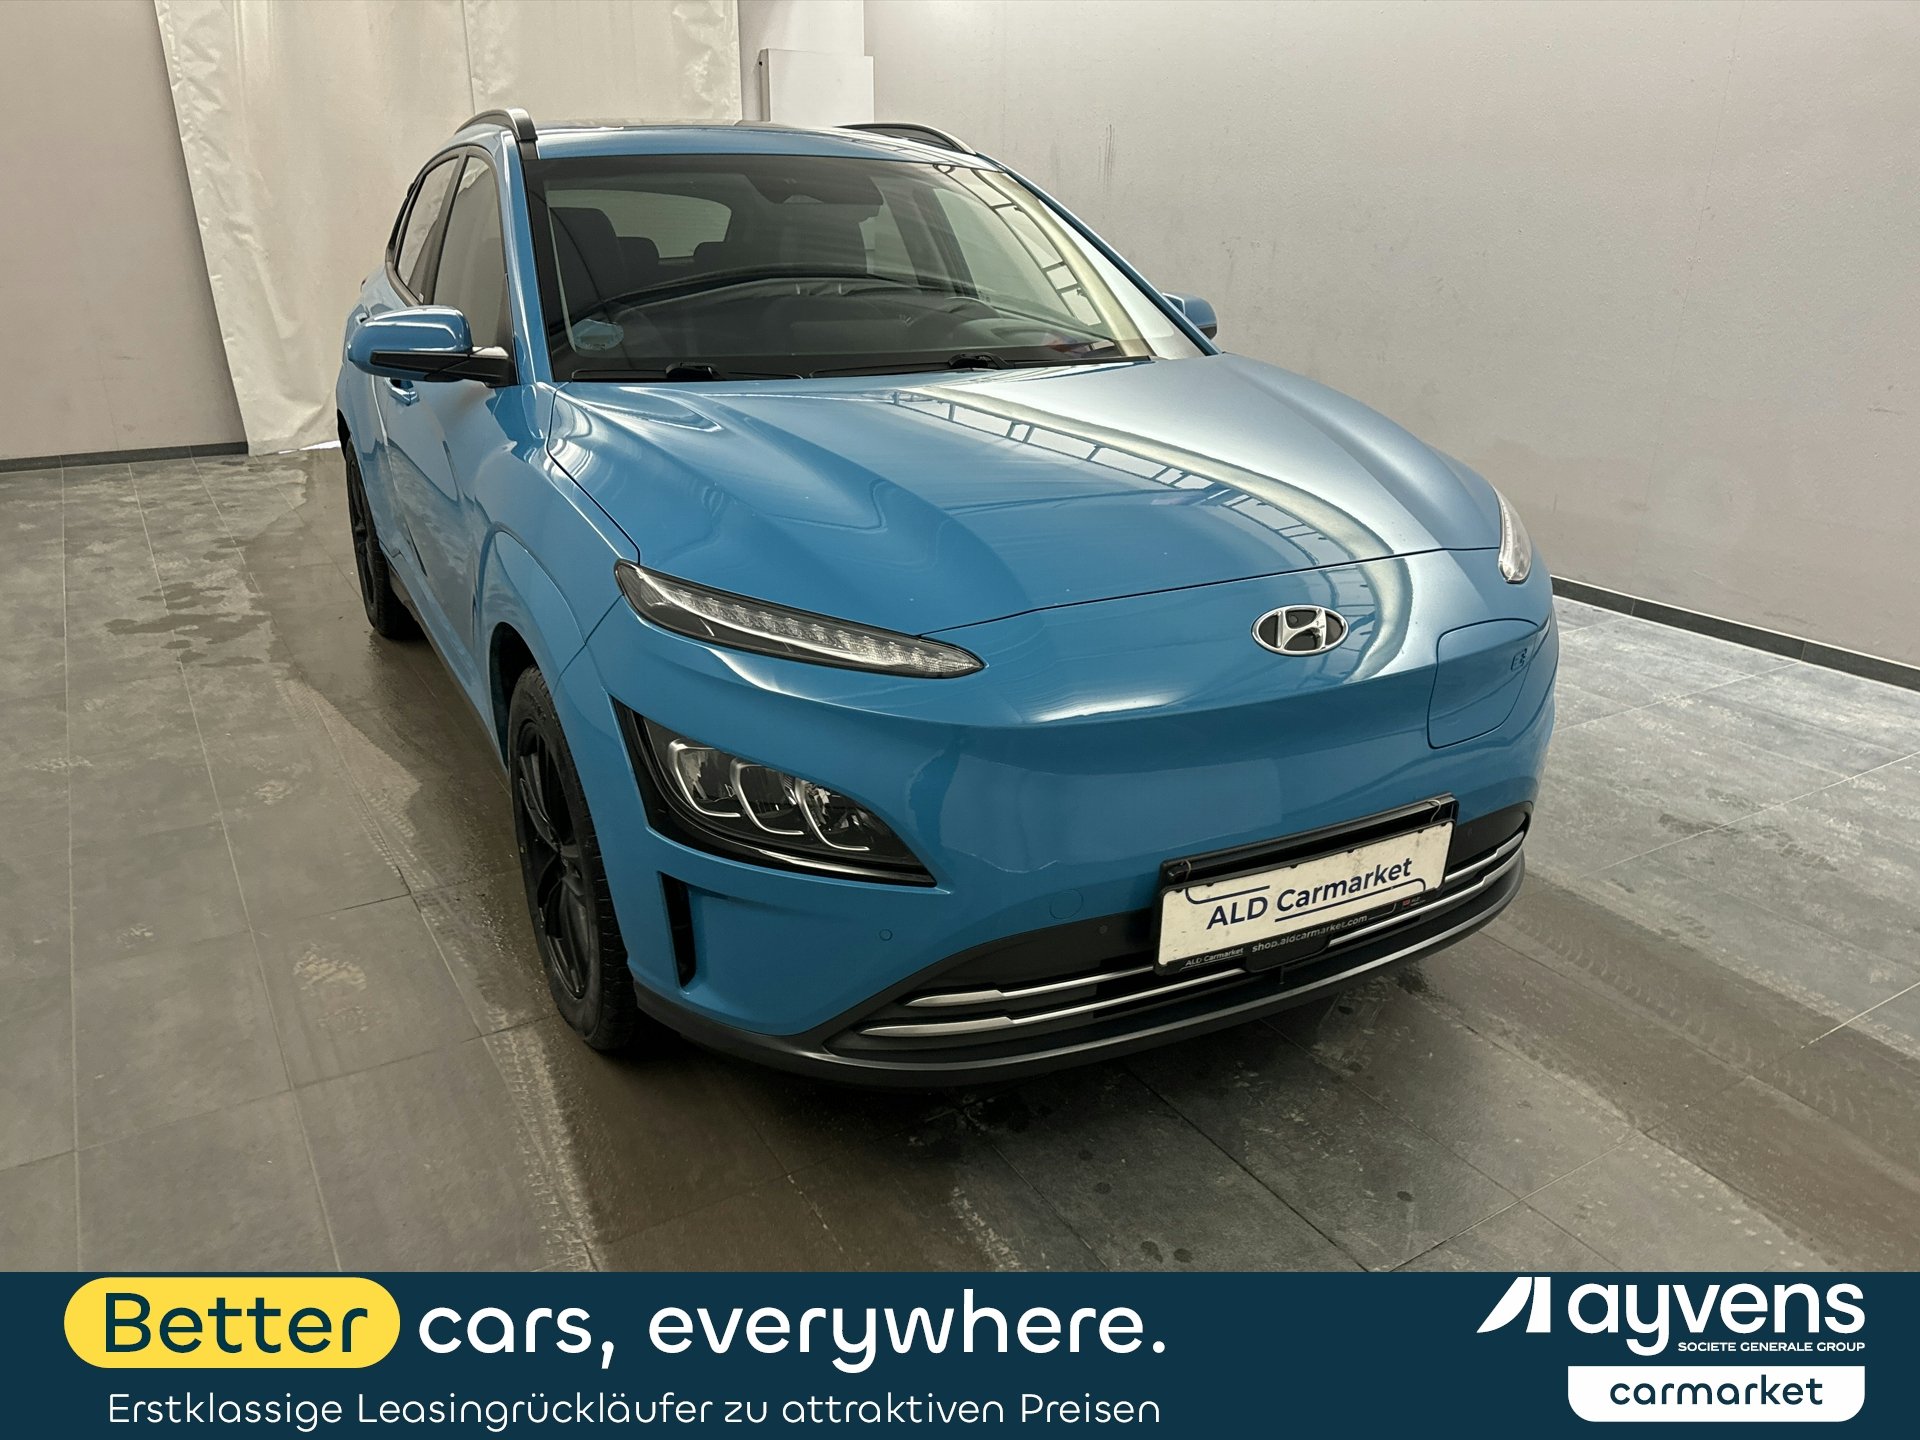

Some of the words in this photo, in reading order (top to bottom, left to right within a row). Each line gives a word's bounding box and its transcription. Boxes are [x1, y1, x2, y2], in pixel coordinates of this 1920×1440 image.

[1206, 896, 1268, 930] ALD
[1276, 857, 1413, 912] Carmarket
[1251, 914, 1368, 953] shop.aldcarmarket.com
[1185, 957, 1202, 967] ALD
[1203, 947, 1244, 963] Carmarket
